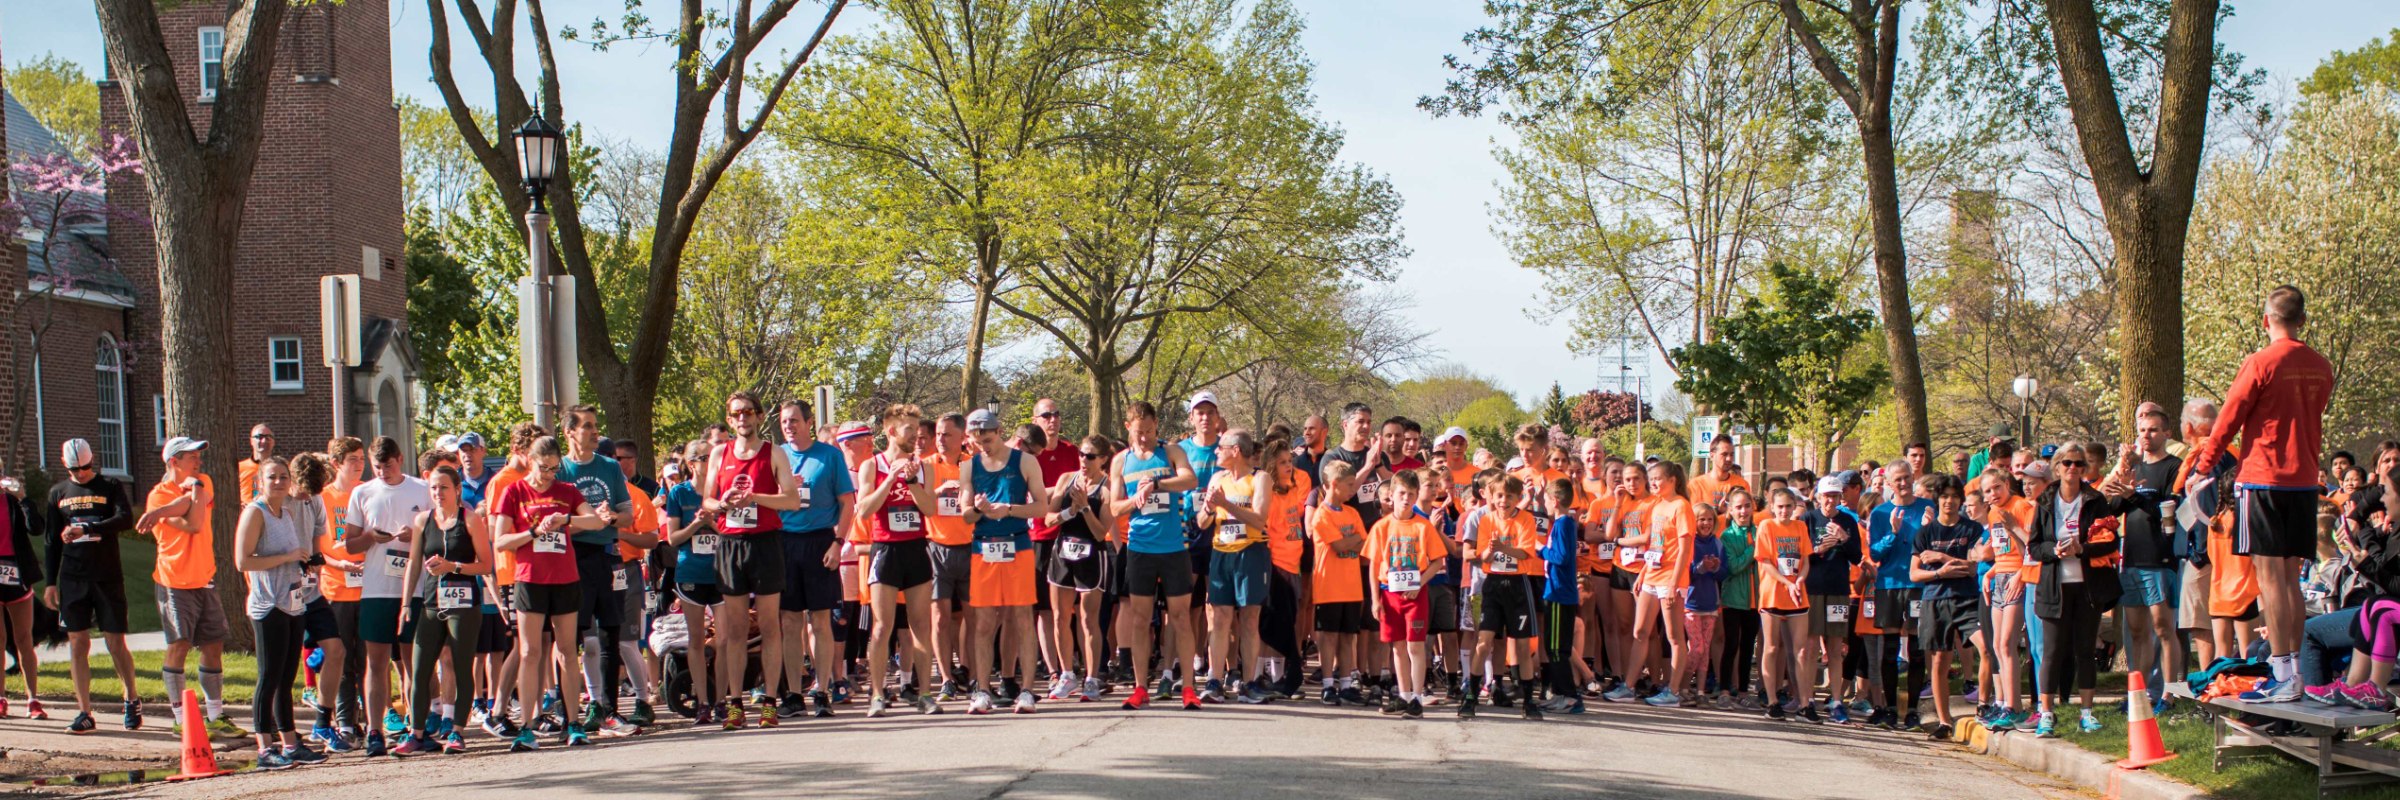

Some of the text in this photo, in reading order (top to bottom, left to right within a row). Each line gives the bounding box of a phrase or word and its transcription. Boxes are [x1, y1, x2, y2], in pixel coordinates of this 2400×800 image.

[70, 503, 93, 511] SOCCER
[895, 512, 915, 522] 558
[1224, 526, 1241, 535] 203
[540, 533, 560, 543] 354
[698, 535, 717, 545] 409
[989, 543, 1009, 553] 512
[1494, 553, 1512, 563] 485
[1394, 572, 1414, 582] 333
[444, 588, 466, 598] 465
[1832, 605, 1848, 615] 253
[1518, 615, 1527, 631] 7
